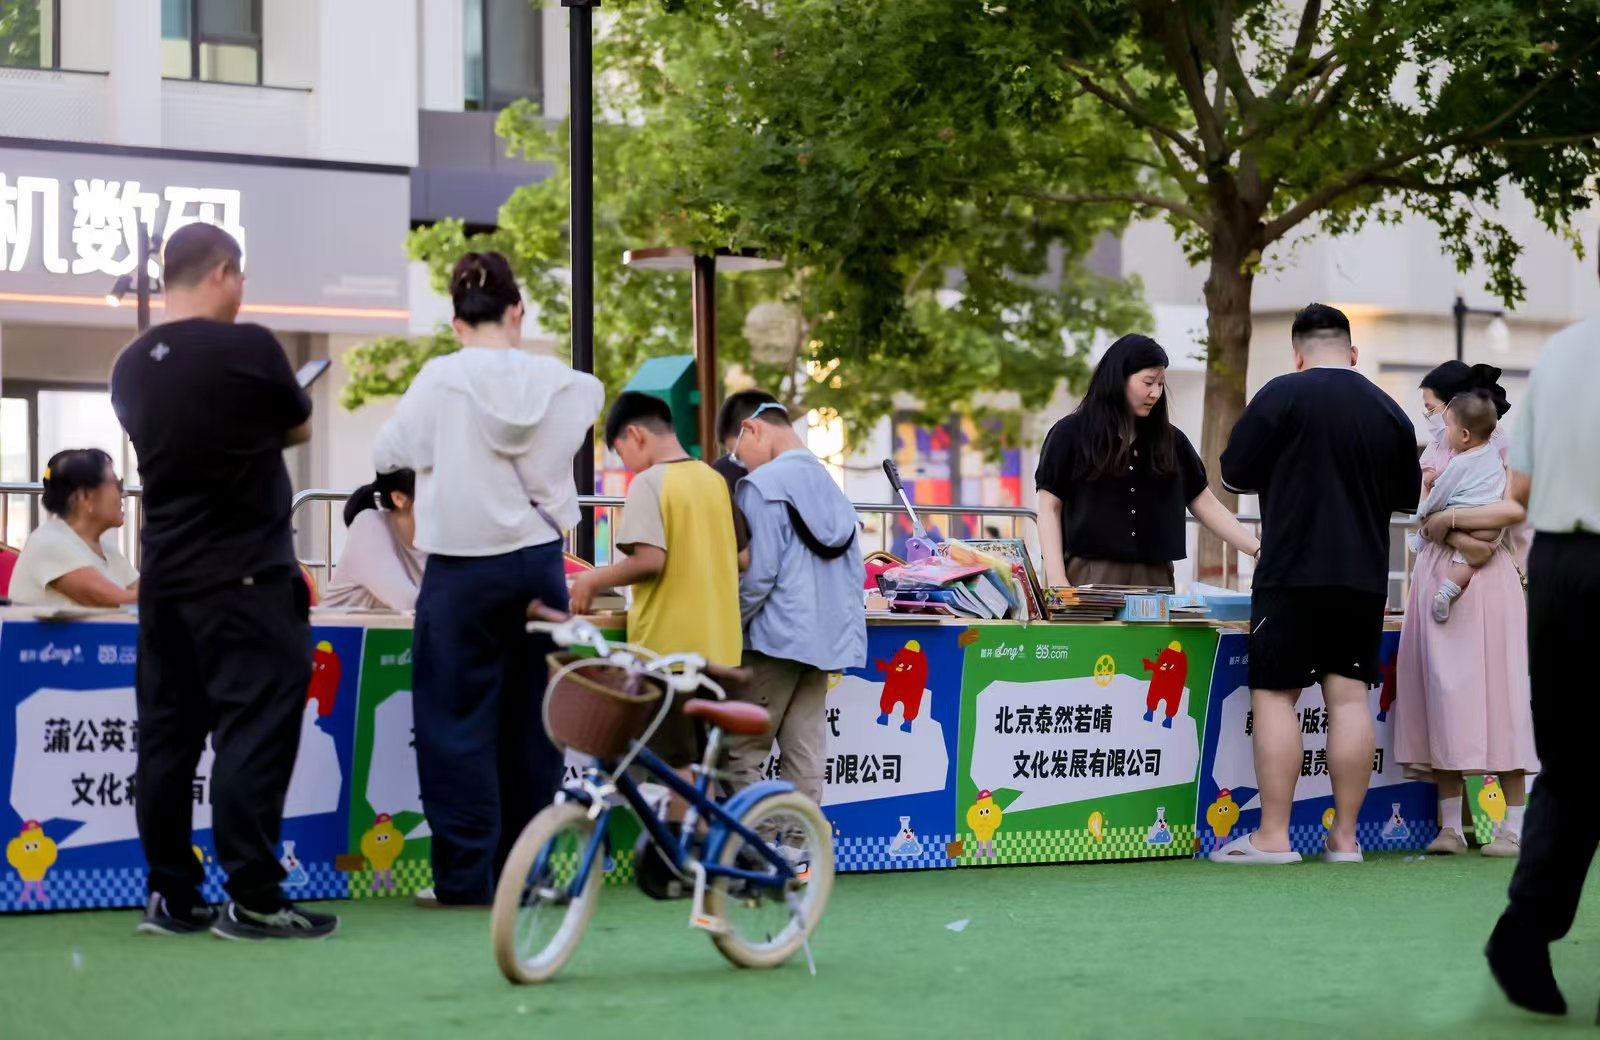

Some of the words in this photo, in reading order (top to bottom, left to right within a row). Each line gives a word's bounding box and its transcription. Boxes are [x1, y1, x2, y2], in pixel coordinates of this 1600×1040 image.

[994, 704, 1113, 734] 北京泰然若晴
[1012, 748, 1162, 779] 文化发展有限公司
